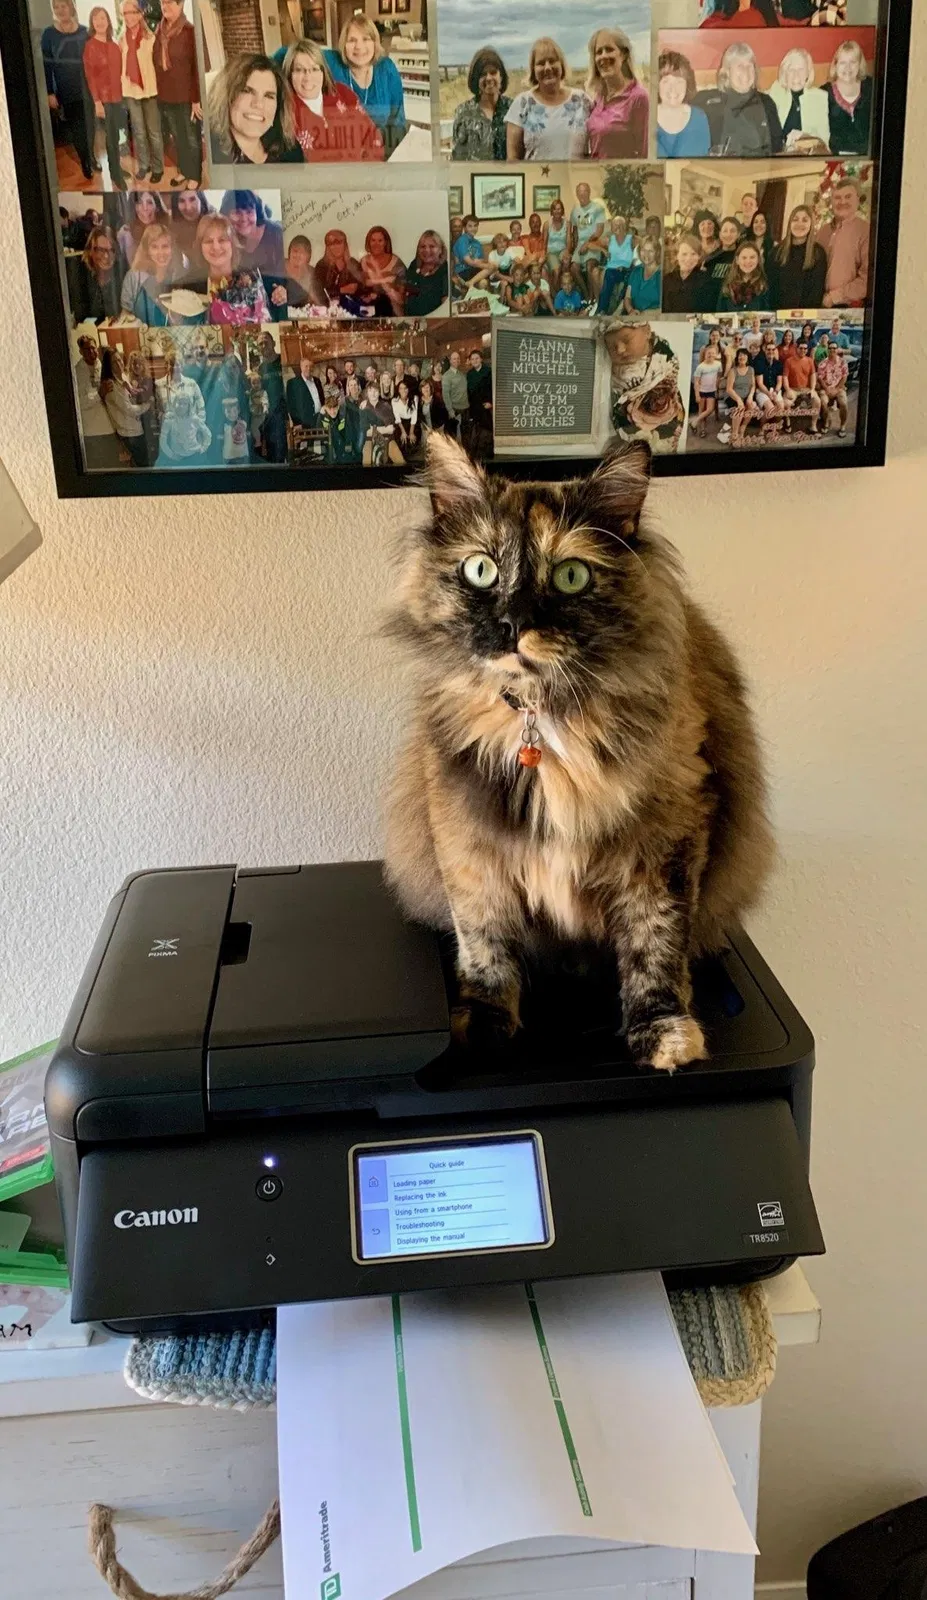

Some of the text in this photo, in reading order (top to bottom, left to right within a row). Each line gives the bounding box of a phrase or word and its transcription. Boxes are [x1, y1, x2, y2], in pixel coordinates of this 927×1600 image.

[519, 338, 575, 353] ALANNA
[519, 350, 574, 365] BRIELLE
[512, 361, 580, 376] MITCHELL
[513, 382, 541, 394] NOV
[555, 384, 578, 395] 2019
[549, 394, 568, 405] PM
[512, 405, 575, 416] 6 LBS 14 OZ
[513, 416, 576, 428] 20 INCHES
[429, 1160, 465, 1169] Quick guide
[393, 1178, 436, 1188] Loading paper
[394, 1193, 423, 1202] Replacing
[425, 1191, 436, 1199] the
[395, 1208, 412, 1217] Using
[414, 1206, 429, 1214] from
[437, 1203, 473, 1213] smartphone
[114, 1207, 199, 1229] Canon
[396, 1220, 445, 1231] Troubleshooting
[397, 1235, 429, 1245] Displaying
[443, 1232, 465, 1241] manual
[750, 1233, 780, 1243] TR8520
[319, 1500, 332, 1573] Ameritrade
